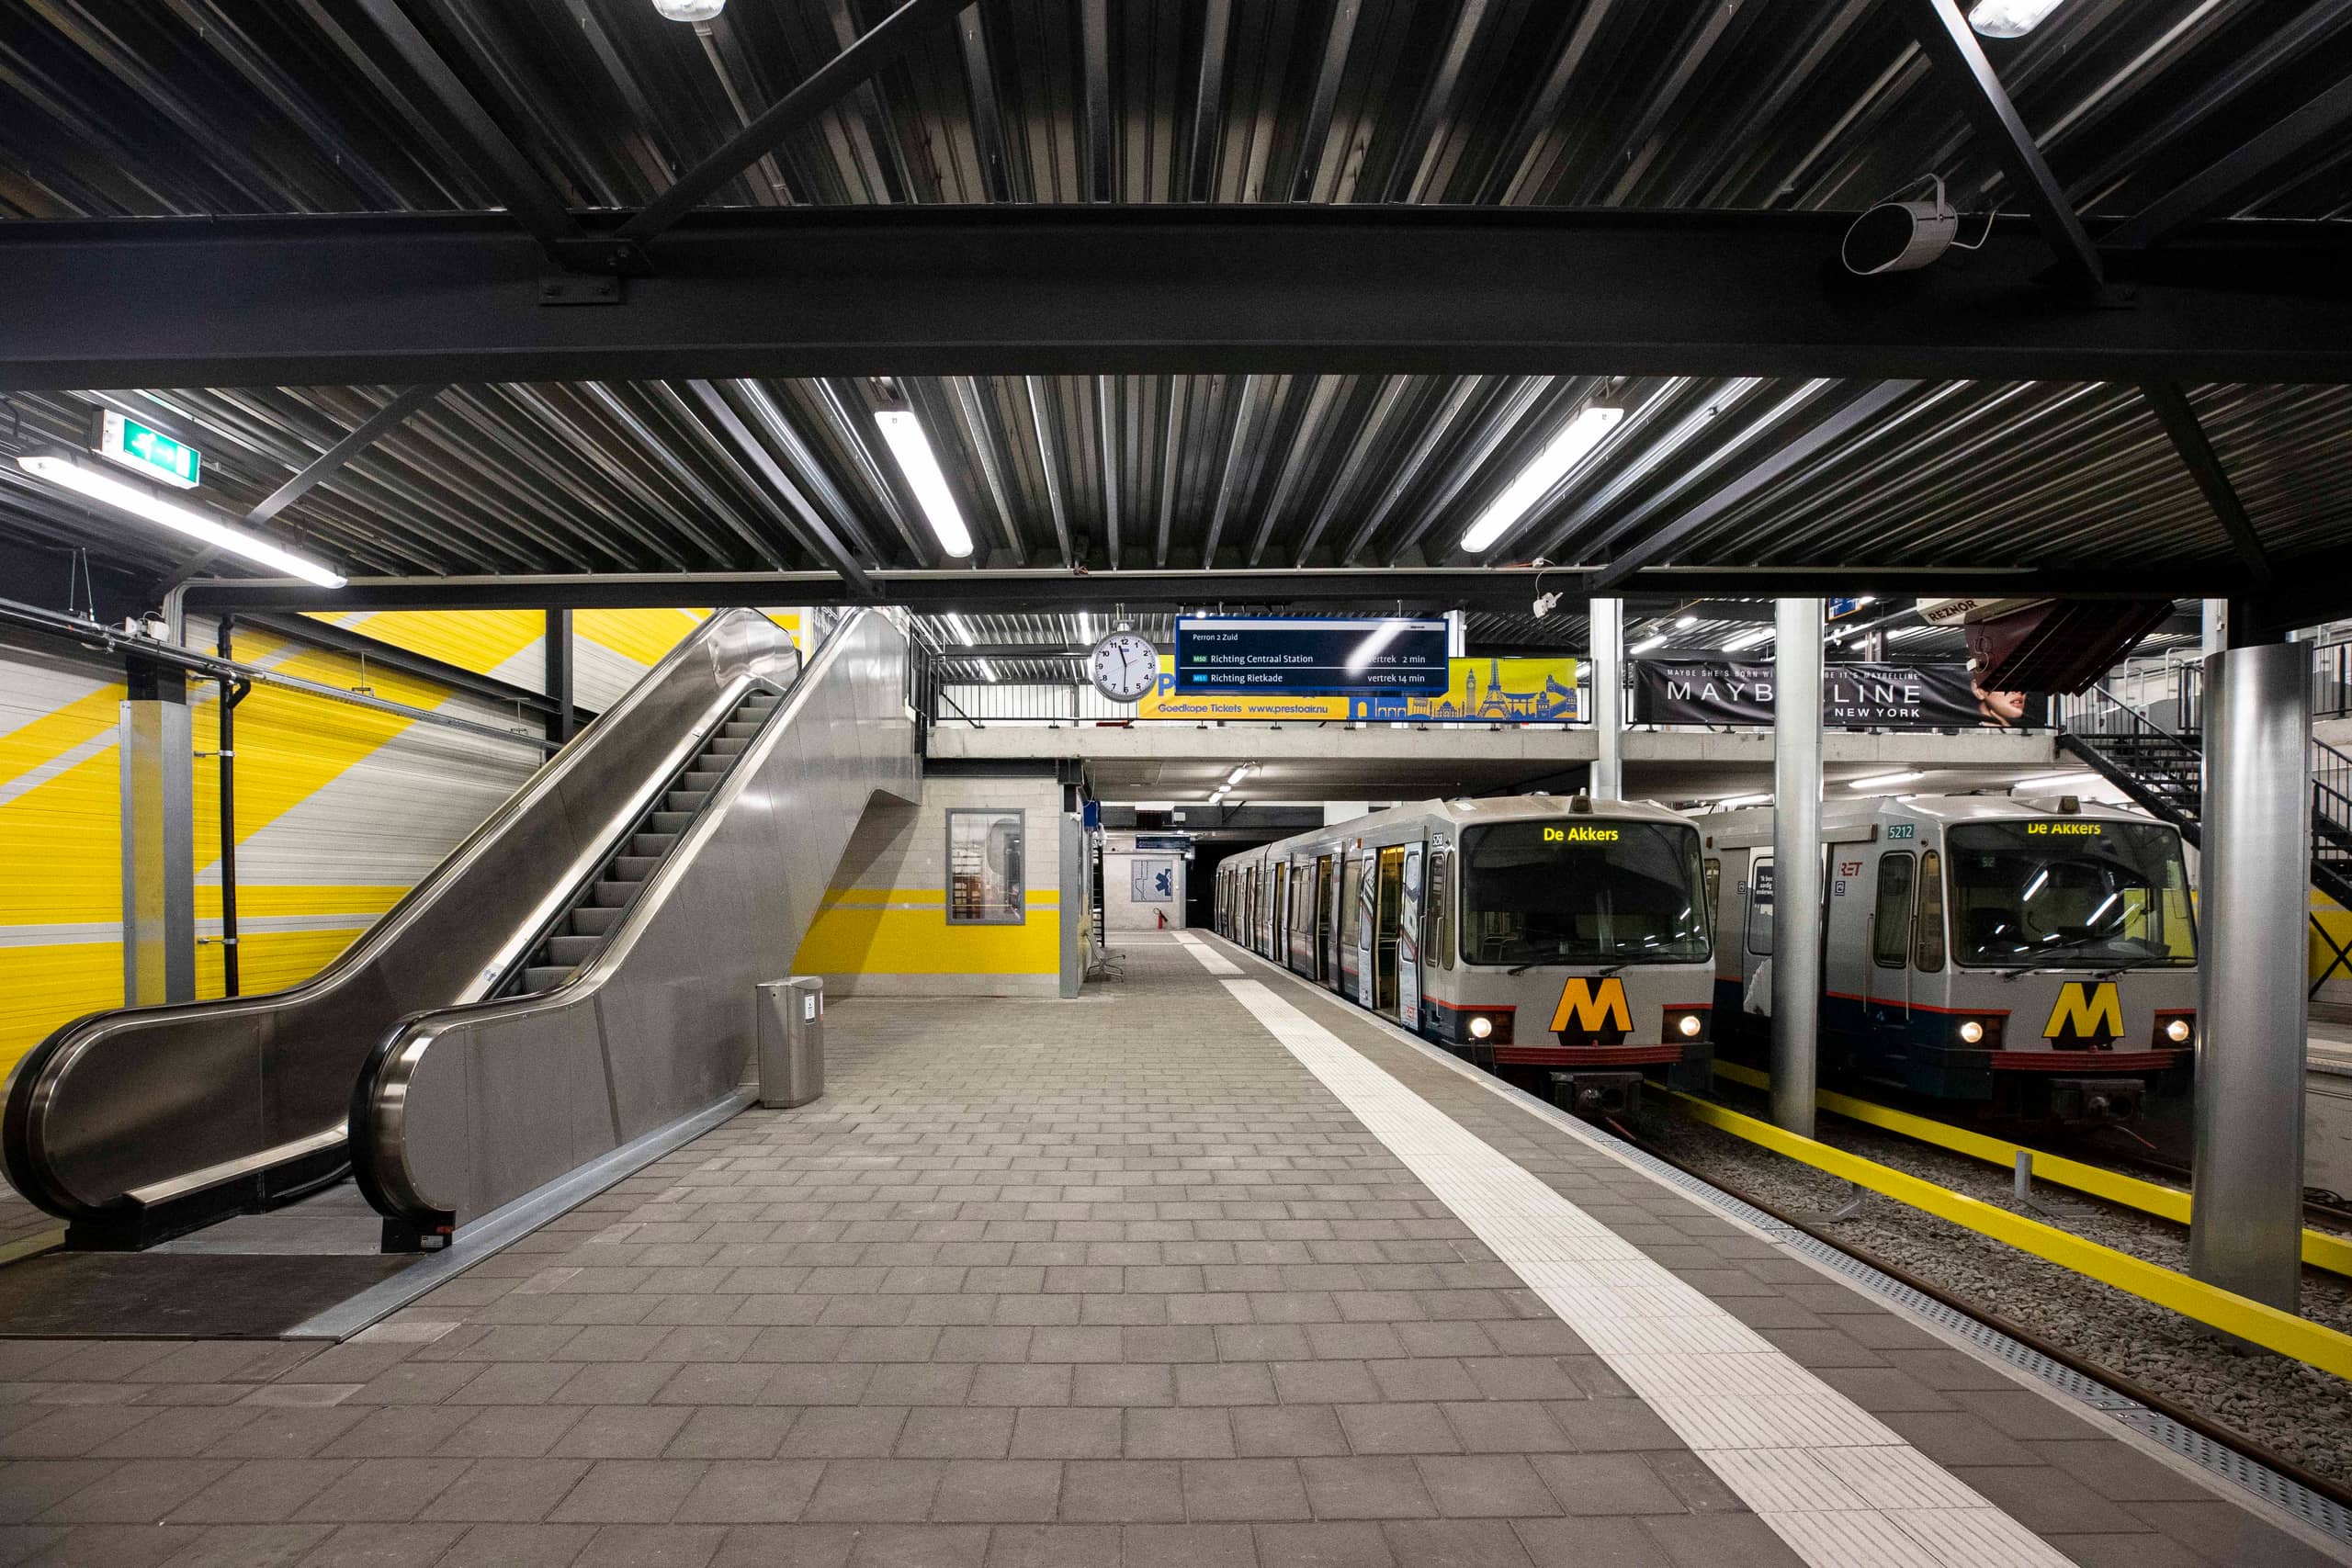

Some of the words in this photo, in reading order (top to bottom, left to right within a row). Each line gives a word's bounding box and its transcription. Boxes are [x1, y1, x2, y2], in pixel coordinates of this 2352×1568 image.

[1928, 599, 1978, 622] REZNOR
[1193, 633, 1216, 641] Perron
[1222, 633, 1238, 641] Zuid
[1211, 654, 1245, 665] Richting
[1247, 654, 1282, 663] Centraal
[1283, 654, 1314, 663] Station
[1367, 655, 1396, 663] vertrek
[1409, 655, 1426, 663] min
[1211, 673, 1245, 684] Richting
[1247, 673, 1283, 682] Rietkade
[1367, 674, 1396, 682] vertrek
[1408, 674, 1425, 682] min
[1668, 669, 1697, 677] MAYBE
[1864, 671, 1919, 680] MAYBELLINE
[1158, 704, 1208, 714] Goedkope
[1211, 704, 1242, 713] Tickets
[1249, 705, 1329, 714] www.prestoair.nu
[1835, 708, 1870, 717] NEW
[1876, 708, 1920, 717] YORK
[1544, 828, 1564, 840] De
[1567, 827, 1619, 840] Akkers
[1889, 826, 1913, 839] 5212
[2028, 823, 2047, 835] De
[2051, 823, 2101, 835] Akkers
